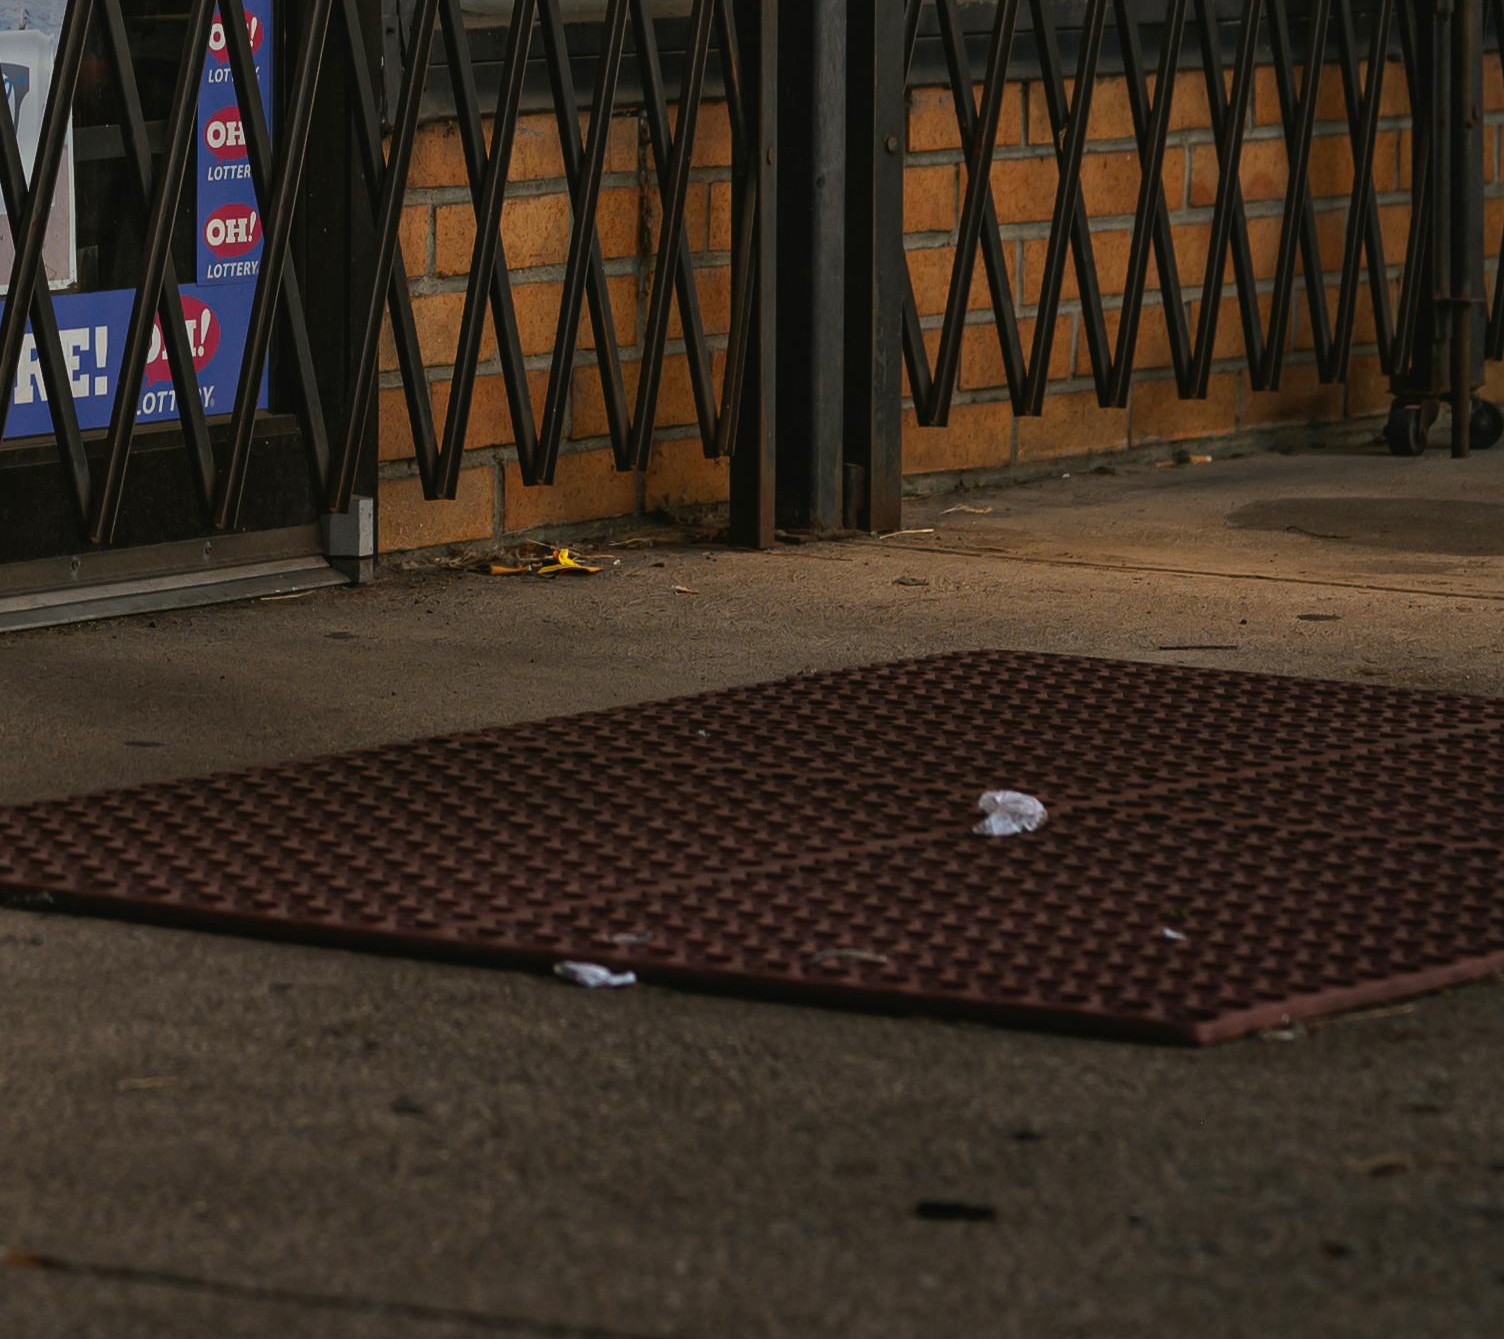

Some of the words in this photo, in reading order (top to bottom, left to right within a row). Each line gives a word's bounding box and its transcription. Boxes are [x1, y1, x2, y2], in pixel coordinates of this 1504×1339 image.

[207, 164, 252, 181] LOTTER
[205, 213, 258, 247] OH!
[206, 260, 259, 279] LOTTERY
